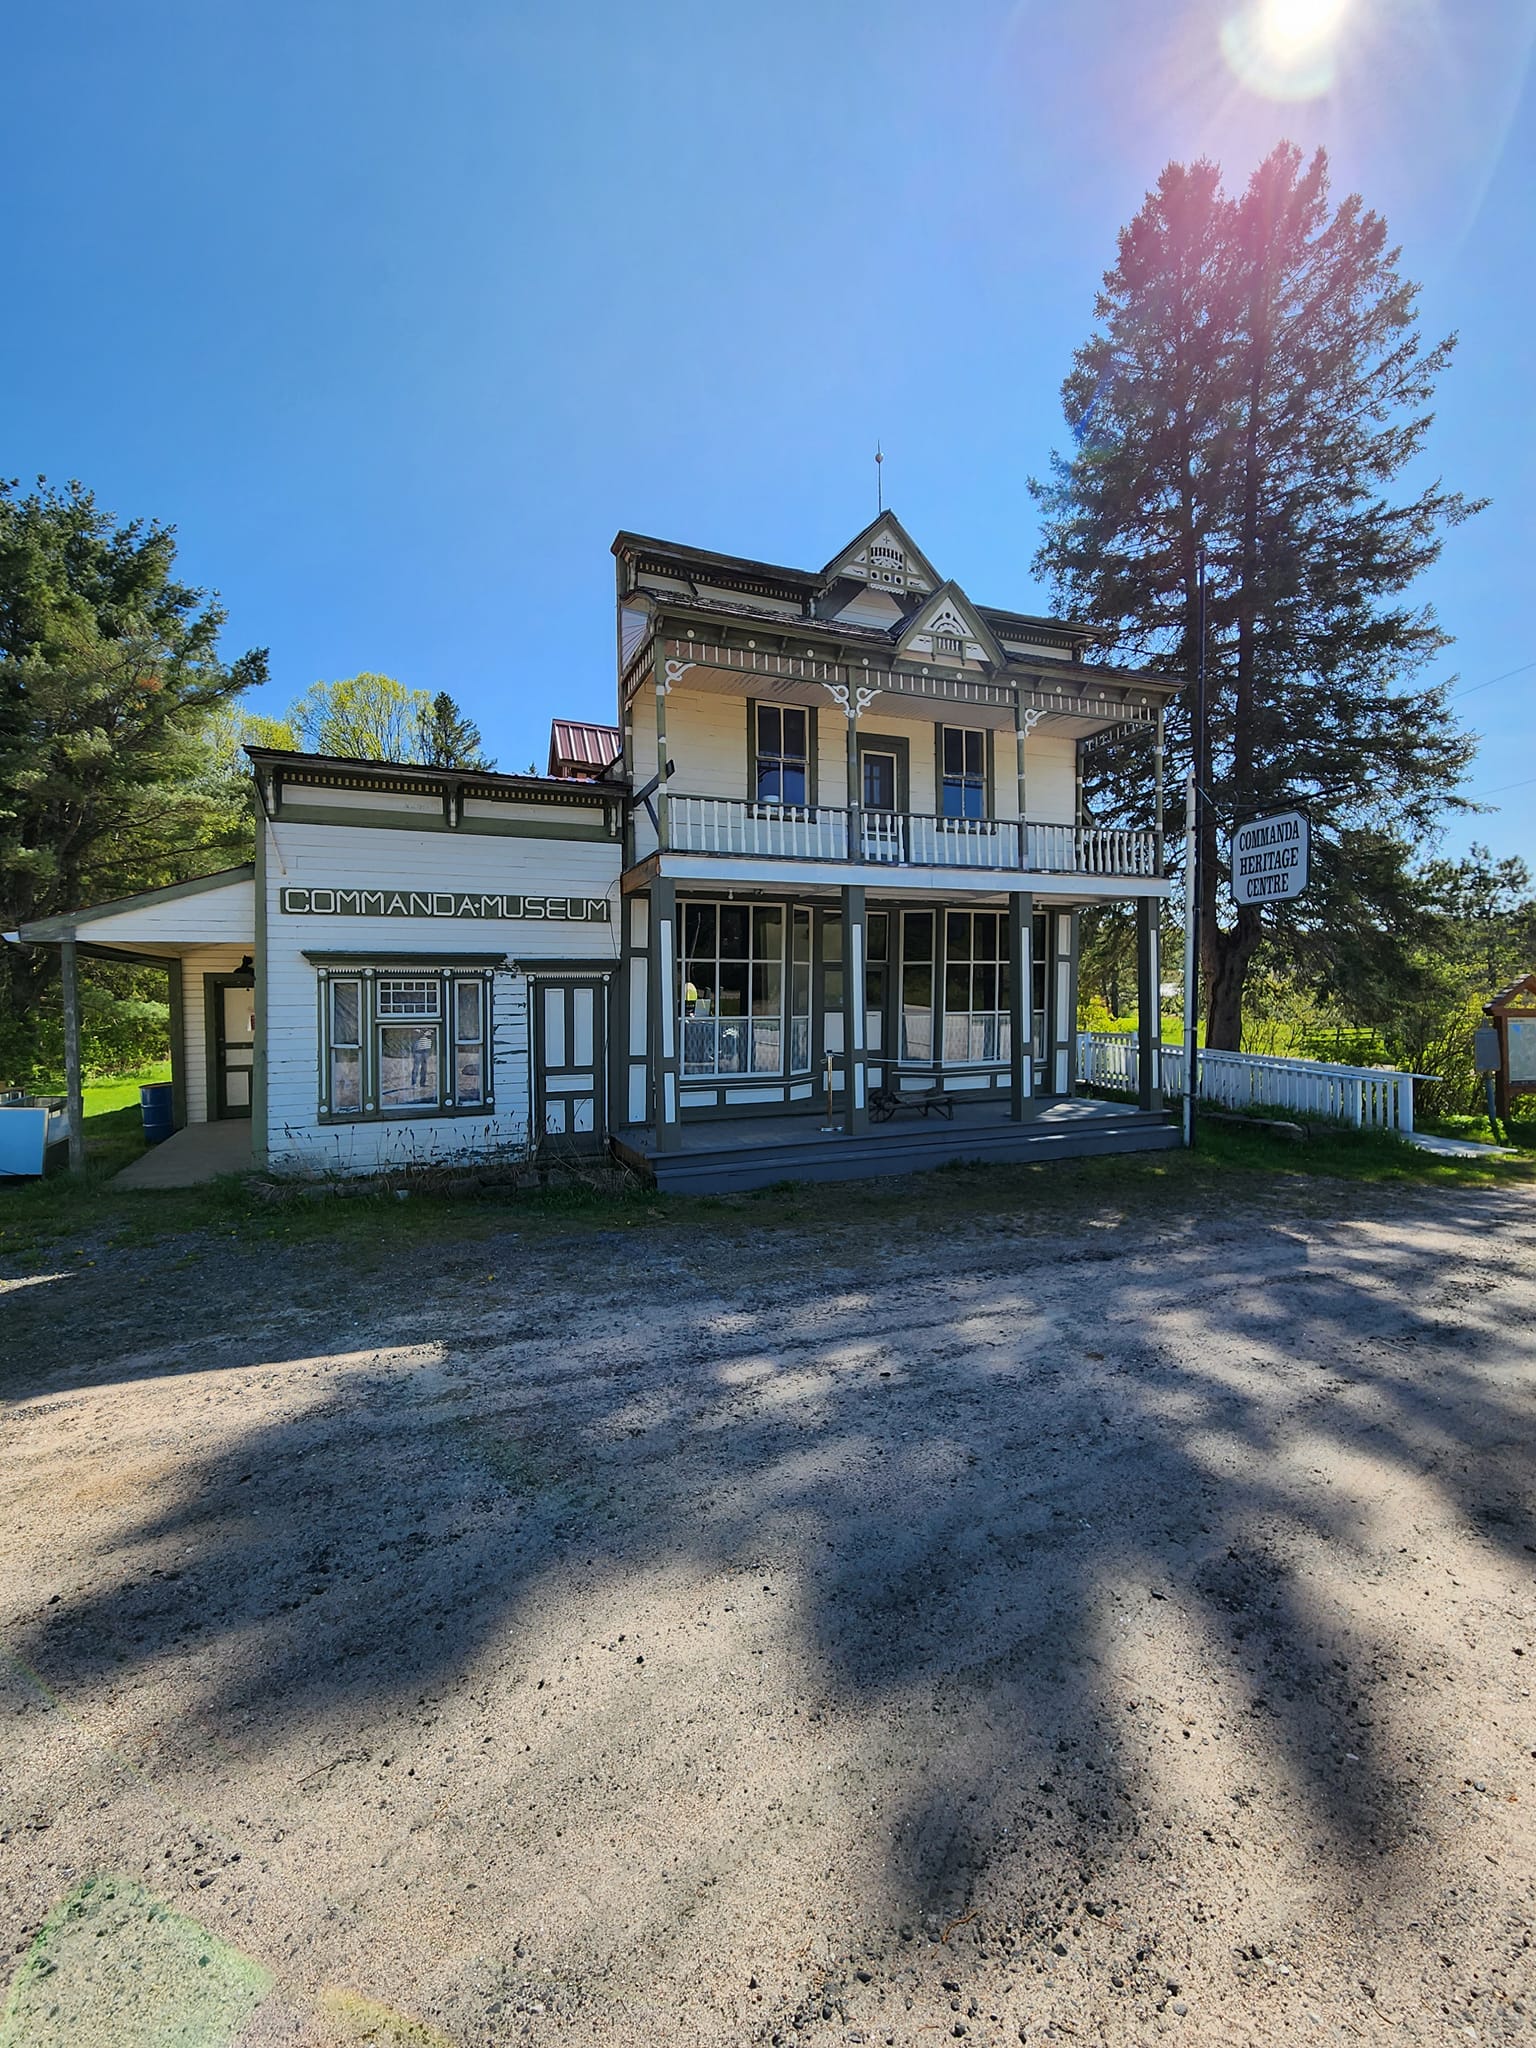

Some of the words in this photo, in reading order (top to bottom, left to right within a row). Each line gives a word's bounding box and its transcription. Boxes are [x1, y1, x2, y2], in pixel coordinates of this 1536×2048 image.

[1239, 820, 1299, 851] COMMANDA
[1240, 847, 1299, 876] HERITAGE
[1247, 873, 1289, 898] CENTRE
